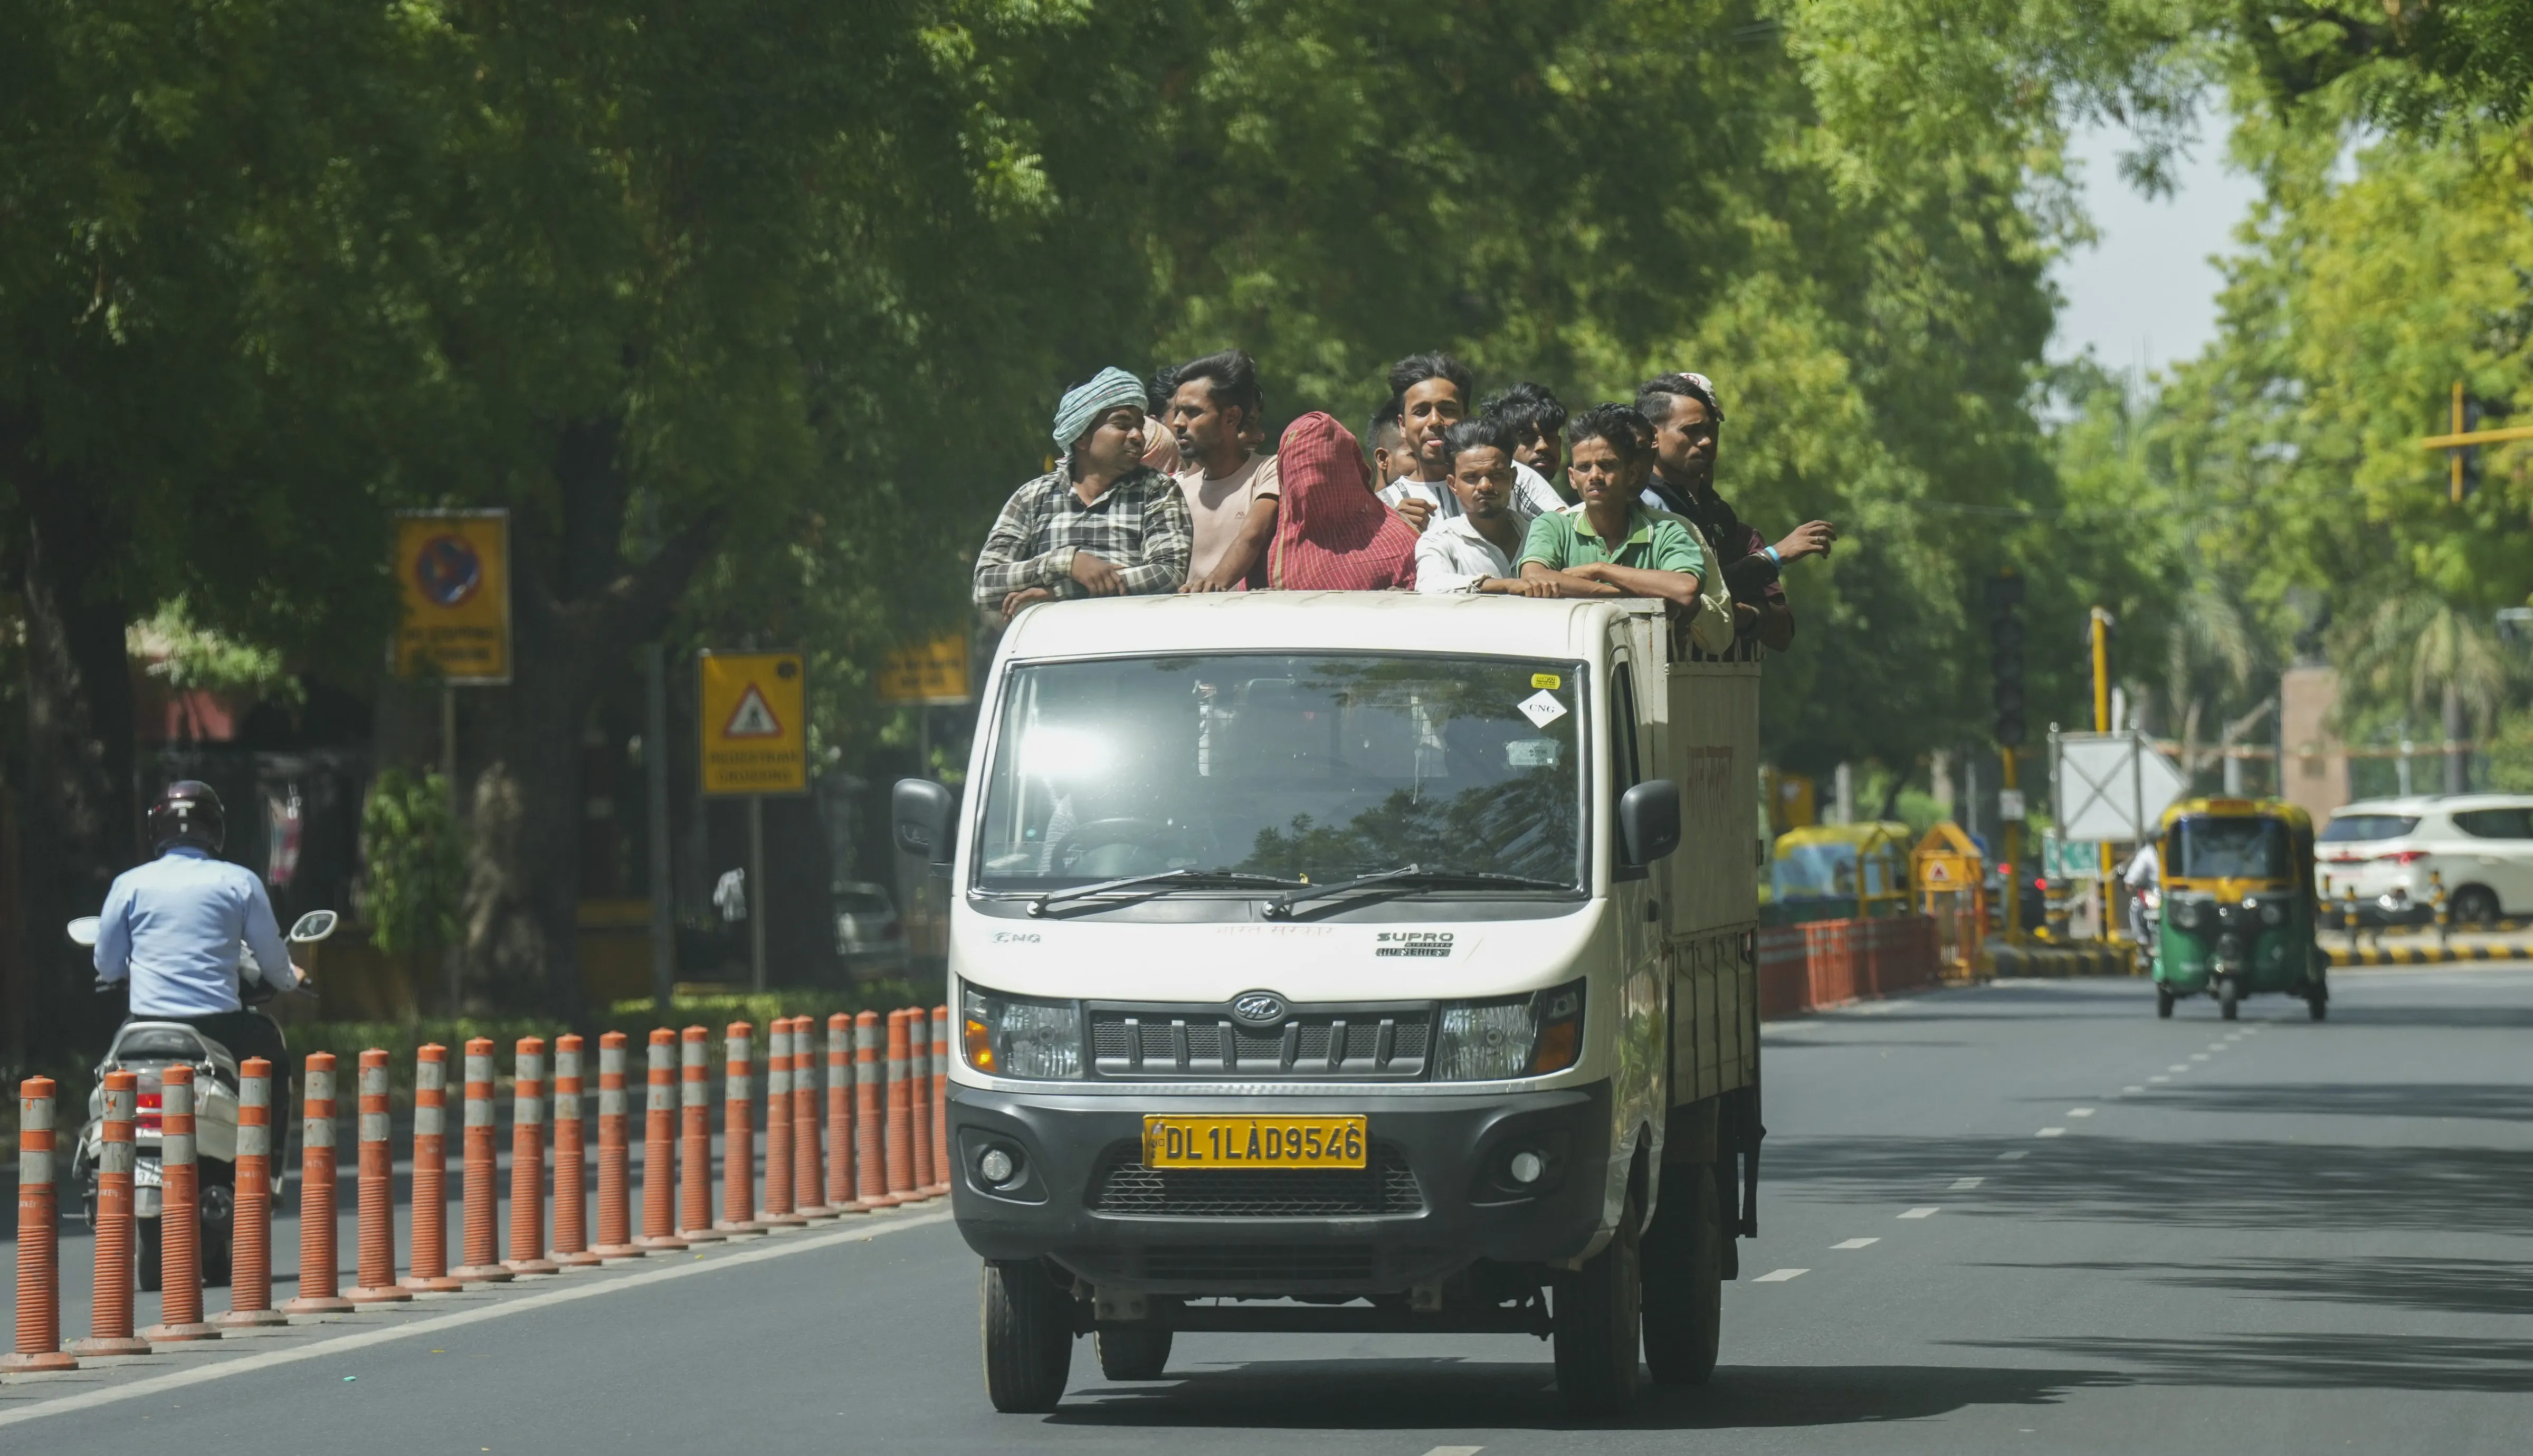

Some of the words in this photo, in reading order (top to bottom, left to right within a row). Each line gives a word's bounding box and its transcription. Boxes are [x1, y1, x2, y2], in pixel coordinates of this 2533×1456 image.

[1529, 704, 1555, 713] CNG
[994, 932, 1041, 944] CNG
[1376, 932, 1454, 941] SUPRO
[1165, 1126, 1362, 1160] DL1LAD9546
